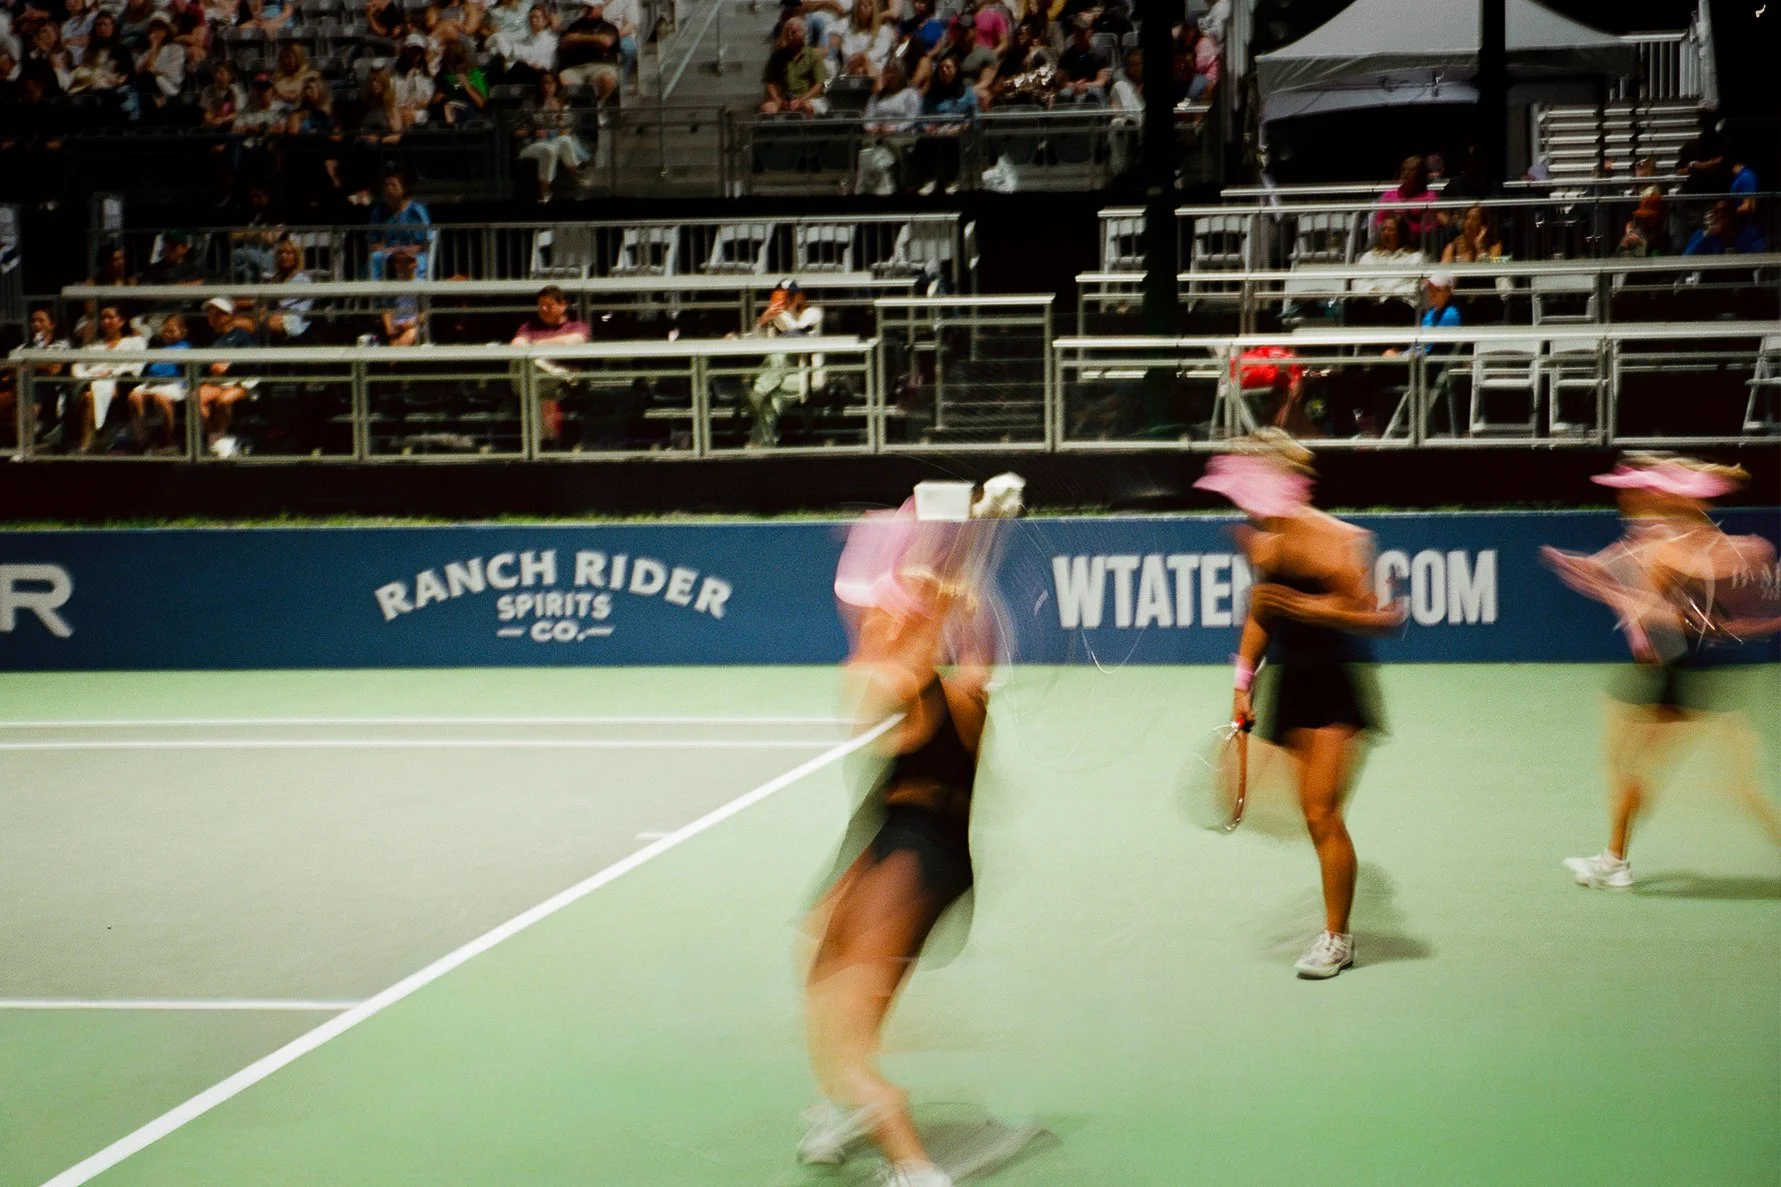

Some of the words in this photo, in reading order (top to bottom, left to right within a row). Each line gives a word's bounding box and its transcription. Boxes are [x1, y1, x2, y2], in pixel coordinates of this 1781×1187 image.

[374, 549, 557, 622] RANCH
[573, 550, 733, 621] RIDER
[496, 590, 613, 621] SPIRITS
